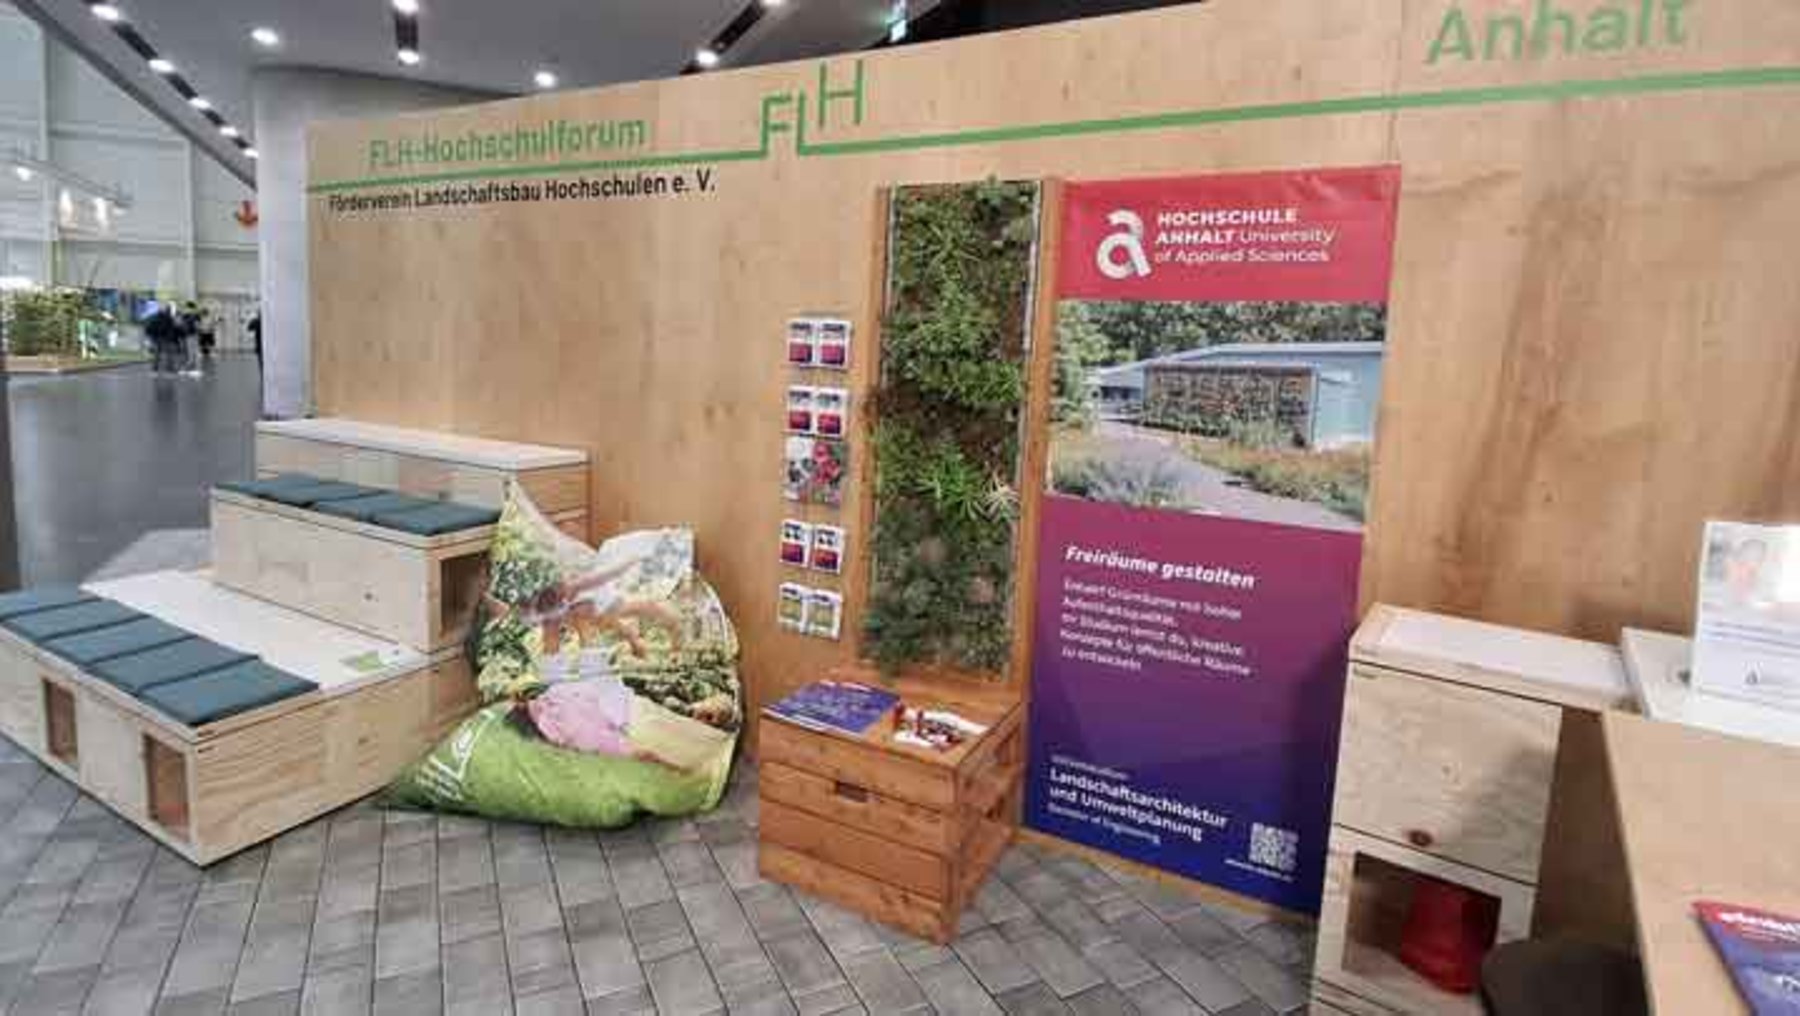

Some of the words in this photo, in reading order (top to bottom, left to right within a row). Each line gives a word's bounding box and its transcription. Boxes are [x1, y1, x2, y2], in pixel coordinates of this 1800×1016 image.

[1424, 0, 1688, 64] Anhalt
[369, 118, 647, 167] FLH-Hochschulforum
[328, 191, 412, 212] Förderverein
[414, 178, 541, 207] Landschaftsbau
[545, 171, 667, 199] Hochschulen
[672, 175, 691, 193] e.
[695, 166, 717, 193] V.
[1154, 228, 1236, 245] ANHALT
[1240, 226, 1336, 244] University
[1157, 207, 1298, 227] HOCHSCHULE
[1154, 246, 1171, 263] of
[1174, 246, 1244, 267] Applied
[1247, 246, 1330, 263] Sciences
[1065, 546, 1159, 574] Freiräume
[1162, 561, 1255, 589] gestalten
[1050, 767, 1227, 827] Landschaftsarchitektur
[1050, 786, 1077, 803] und
[1081, 793, 1202, 842] Umweltplanung
